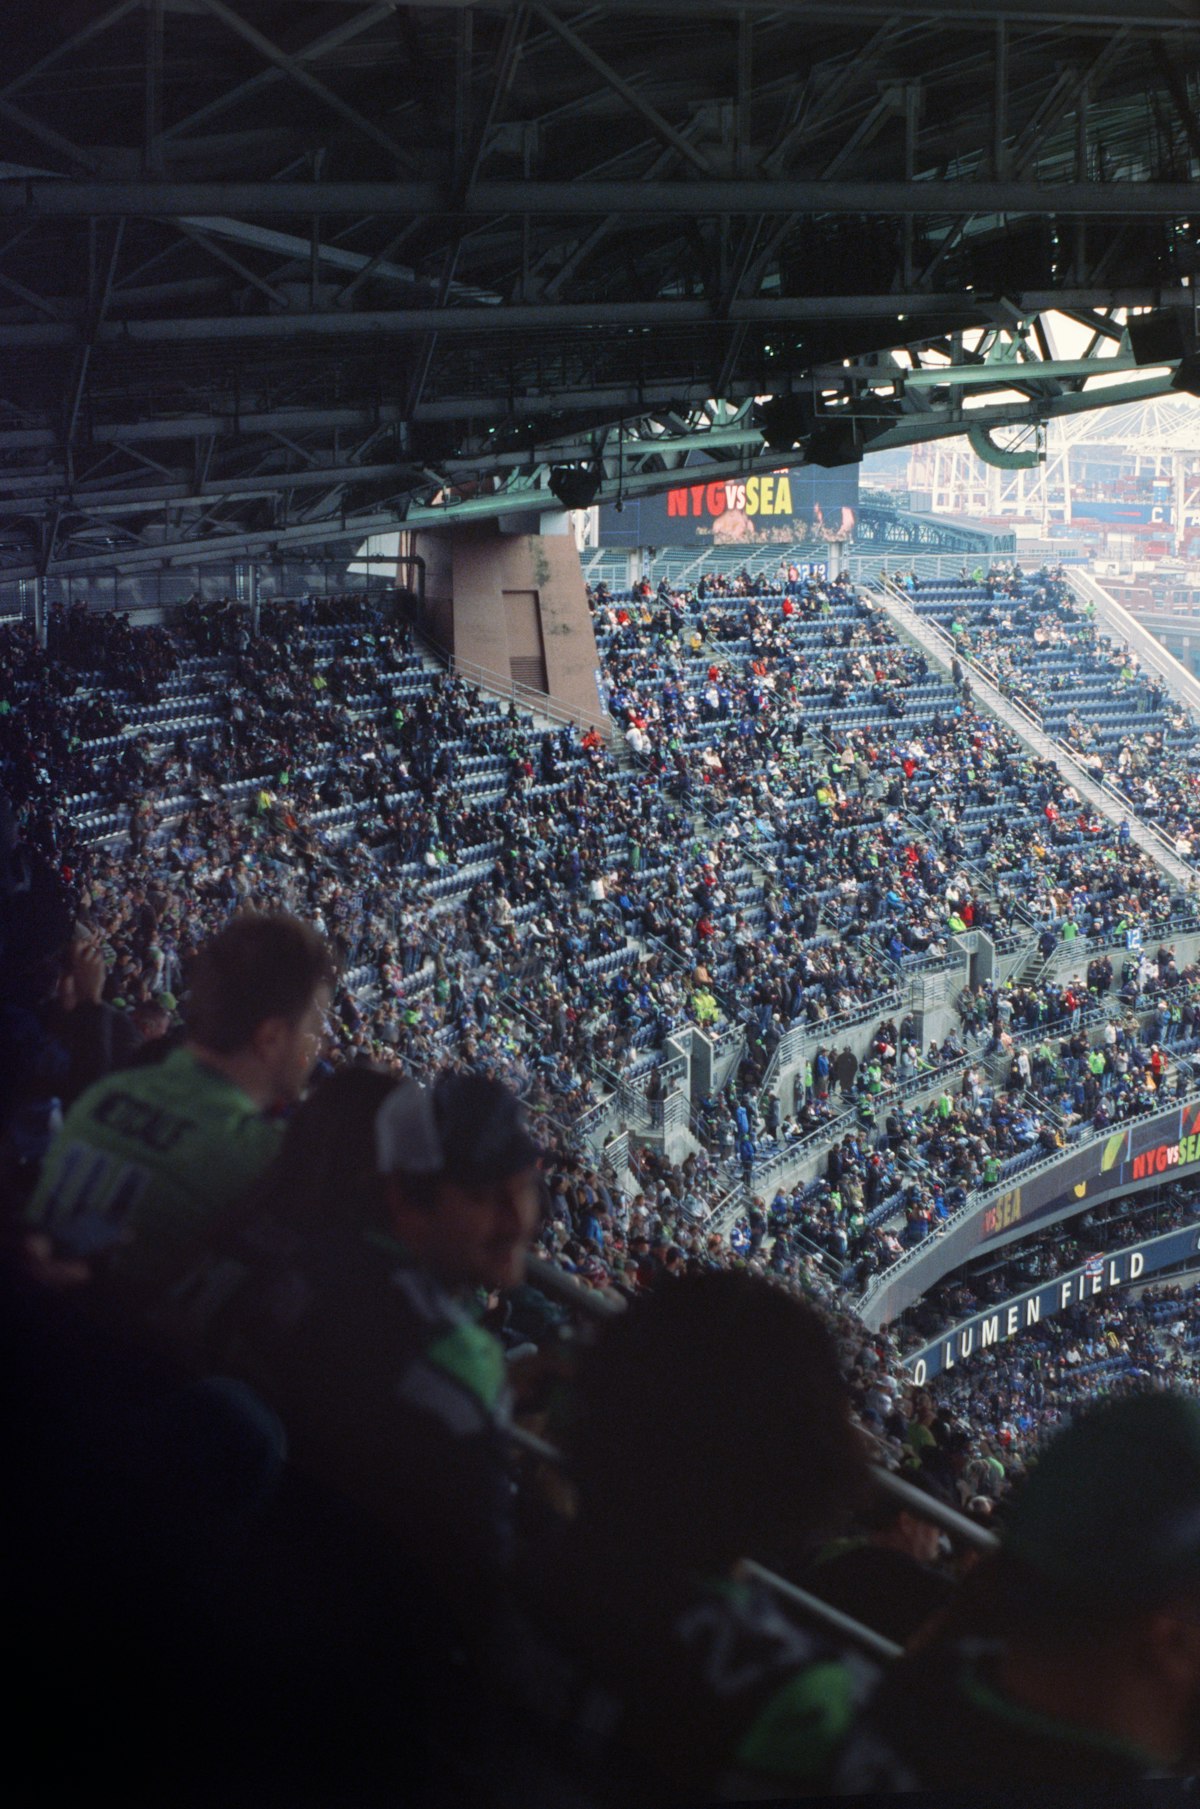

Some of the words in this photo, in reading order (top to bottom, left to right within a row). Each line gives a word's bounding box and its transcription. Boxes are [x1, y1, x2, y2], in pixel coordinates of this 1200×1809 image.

[667, 480, 725, 517] NYG
[745, 476, 793, 516] SEA
[1127, 929, 1140, 949] 12
[1132, 1145, 1169, 1180] NYG
[995, 1187, 1021, 1232] SEA
[945, 1296, 1040, 1370] LUMEN
[1061, 1252, 1144, 1309] FIELD
